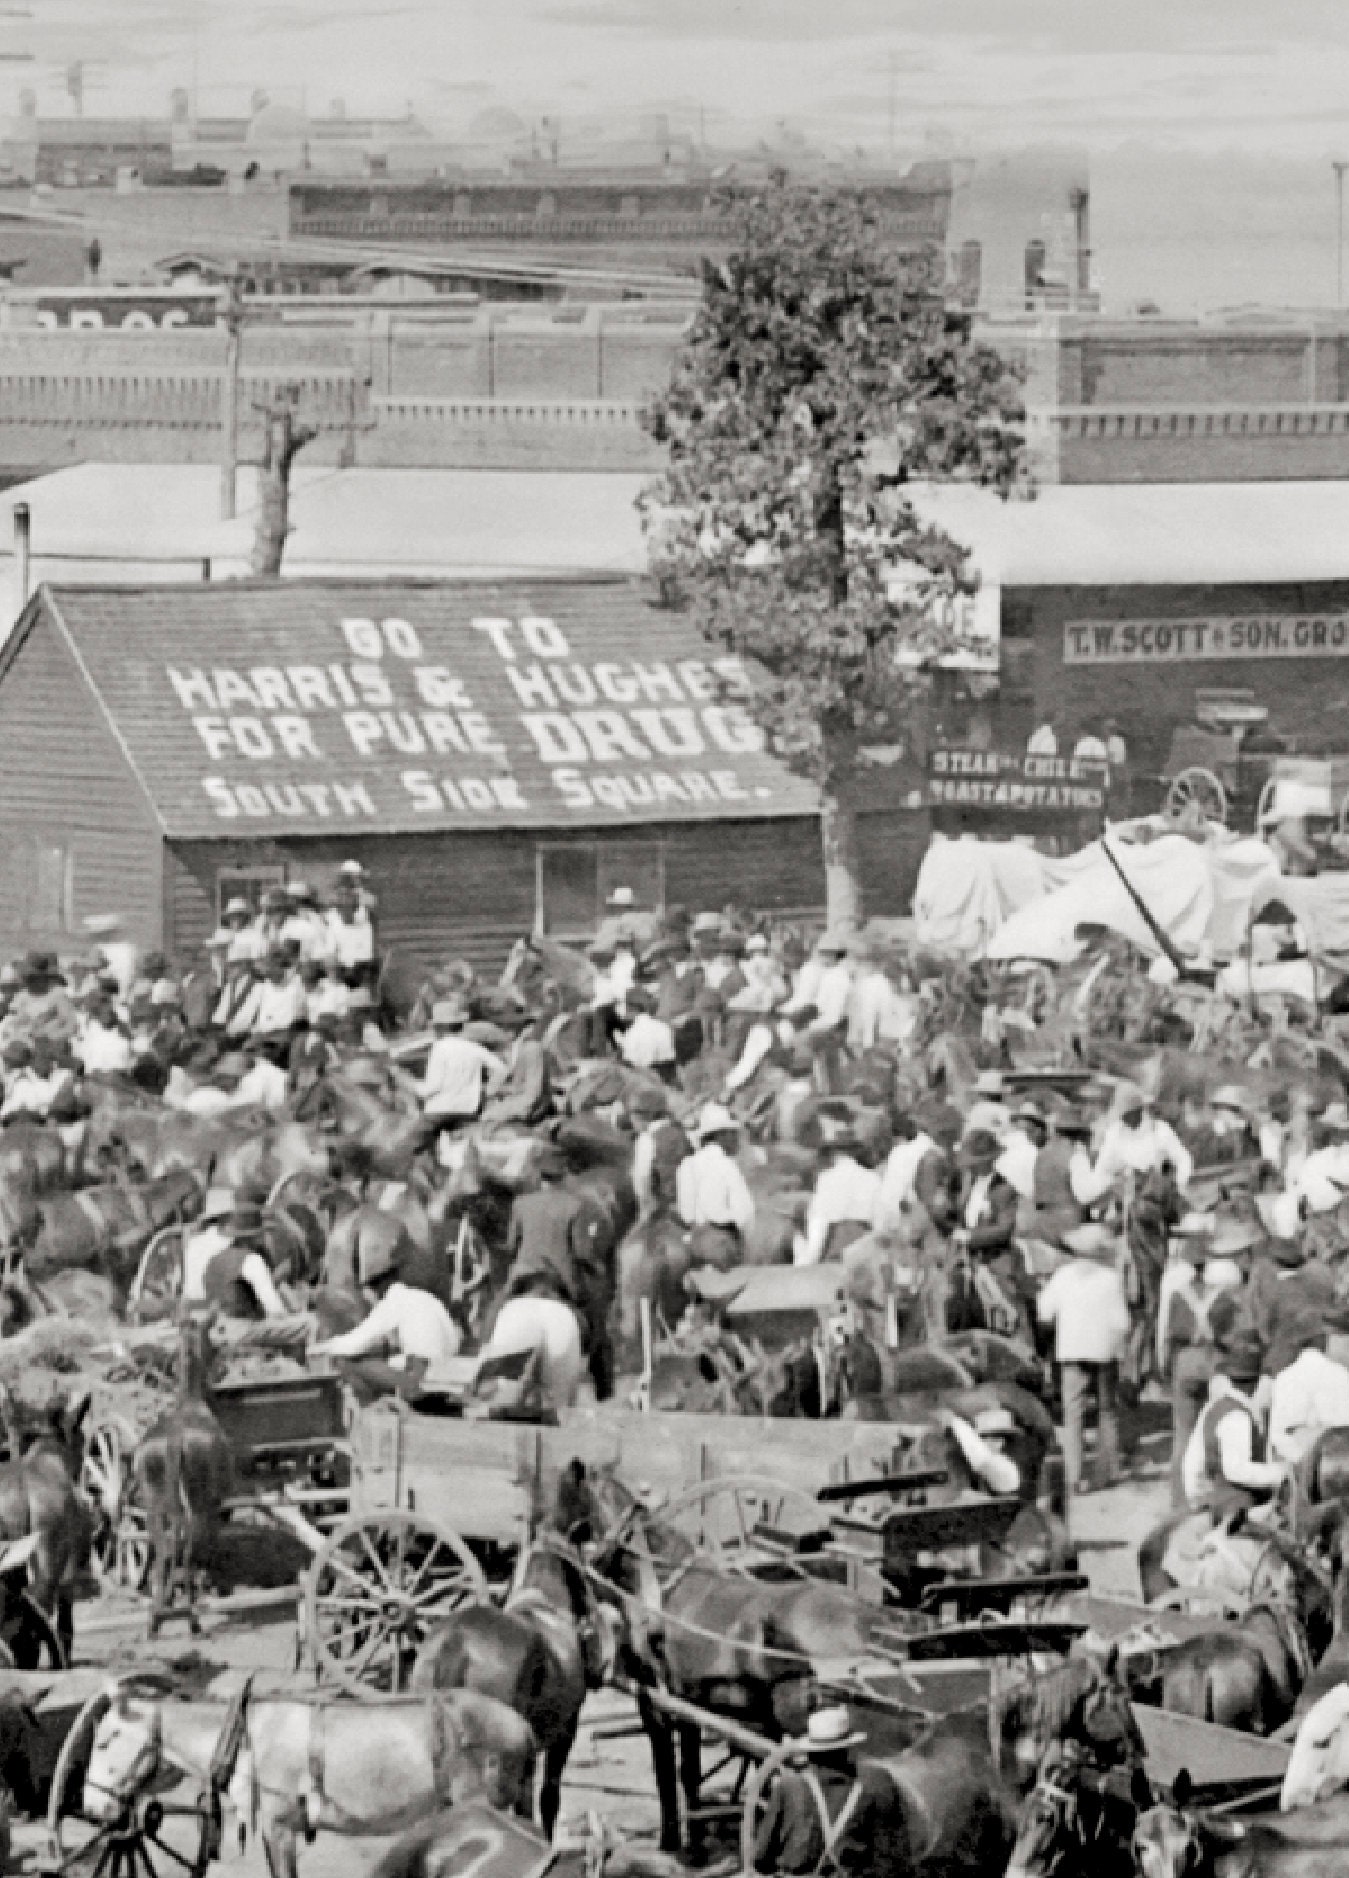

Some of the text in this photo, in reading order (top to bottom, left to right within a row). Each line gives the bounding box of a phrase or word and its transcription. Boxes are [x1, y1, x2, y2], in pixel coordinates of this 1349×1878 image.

[341, 618, 569, 659] GO TO
[166, 664, 393, 708] HARRIS
[412, 666, 472, 708] &
[192, 716, 322, 760] FOR
[342, 711, 506, 755] PURE
[200, 776, 377, 818] SOUTH
